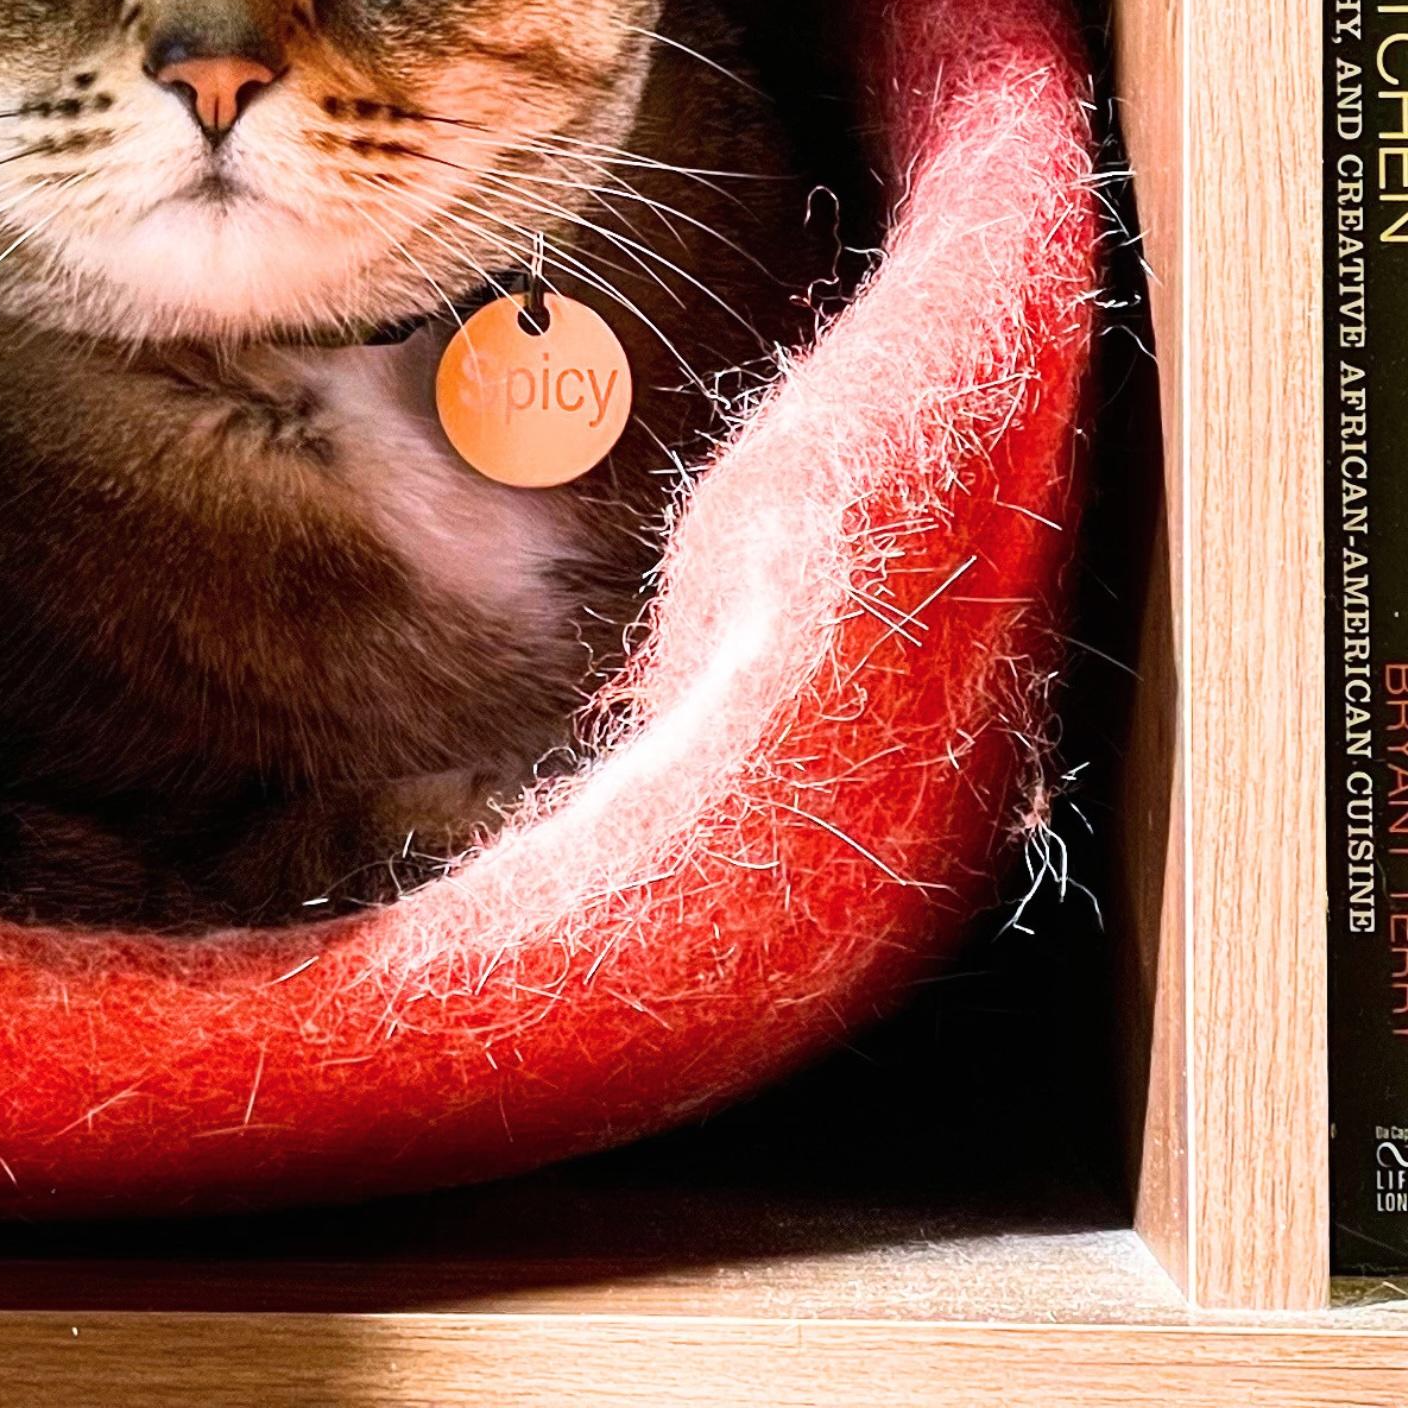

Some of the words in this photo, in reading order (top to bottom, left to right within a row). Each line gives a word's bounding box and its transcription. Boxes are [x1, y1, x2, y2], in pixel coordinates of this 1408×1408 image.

[1336, 57, 1362, 140] AND
[1337, 154, 1366, 348] CREATIVE
[460, 351, 618, 427] Spicy
[1340, 361, 1371, 758] AFRICAN-AMERICAN
[1346, 771, 1375, 933] CUISINE
